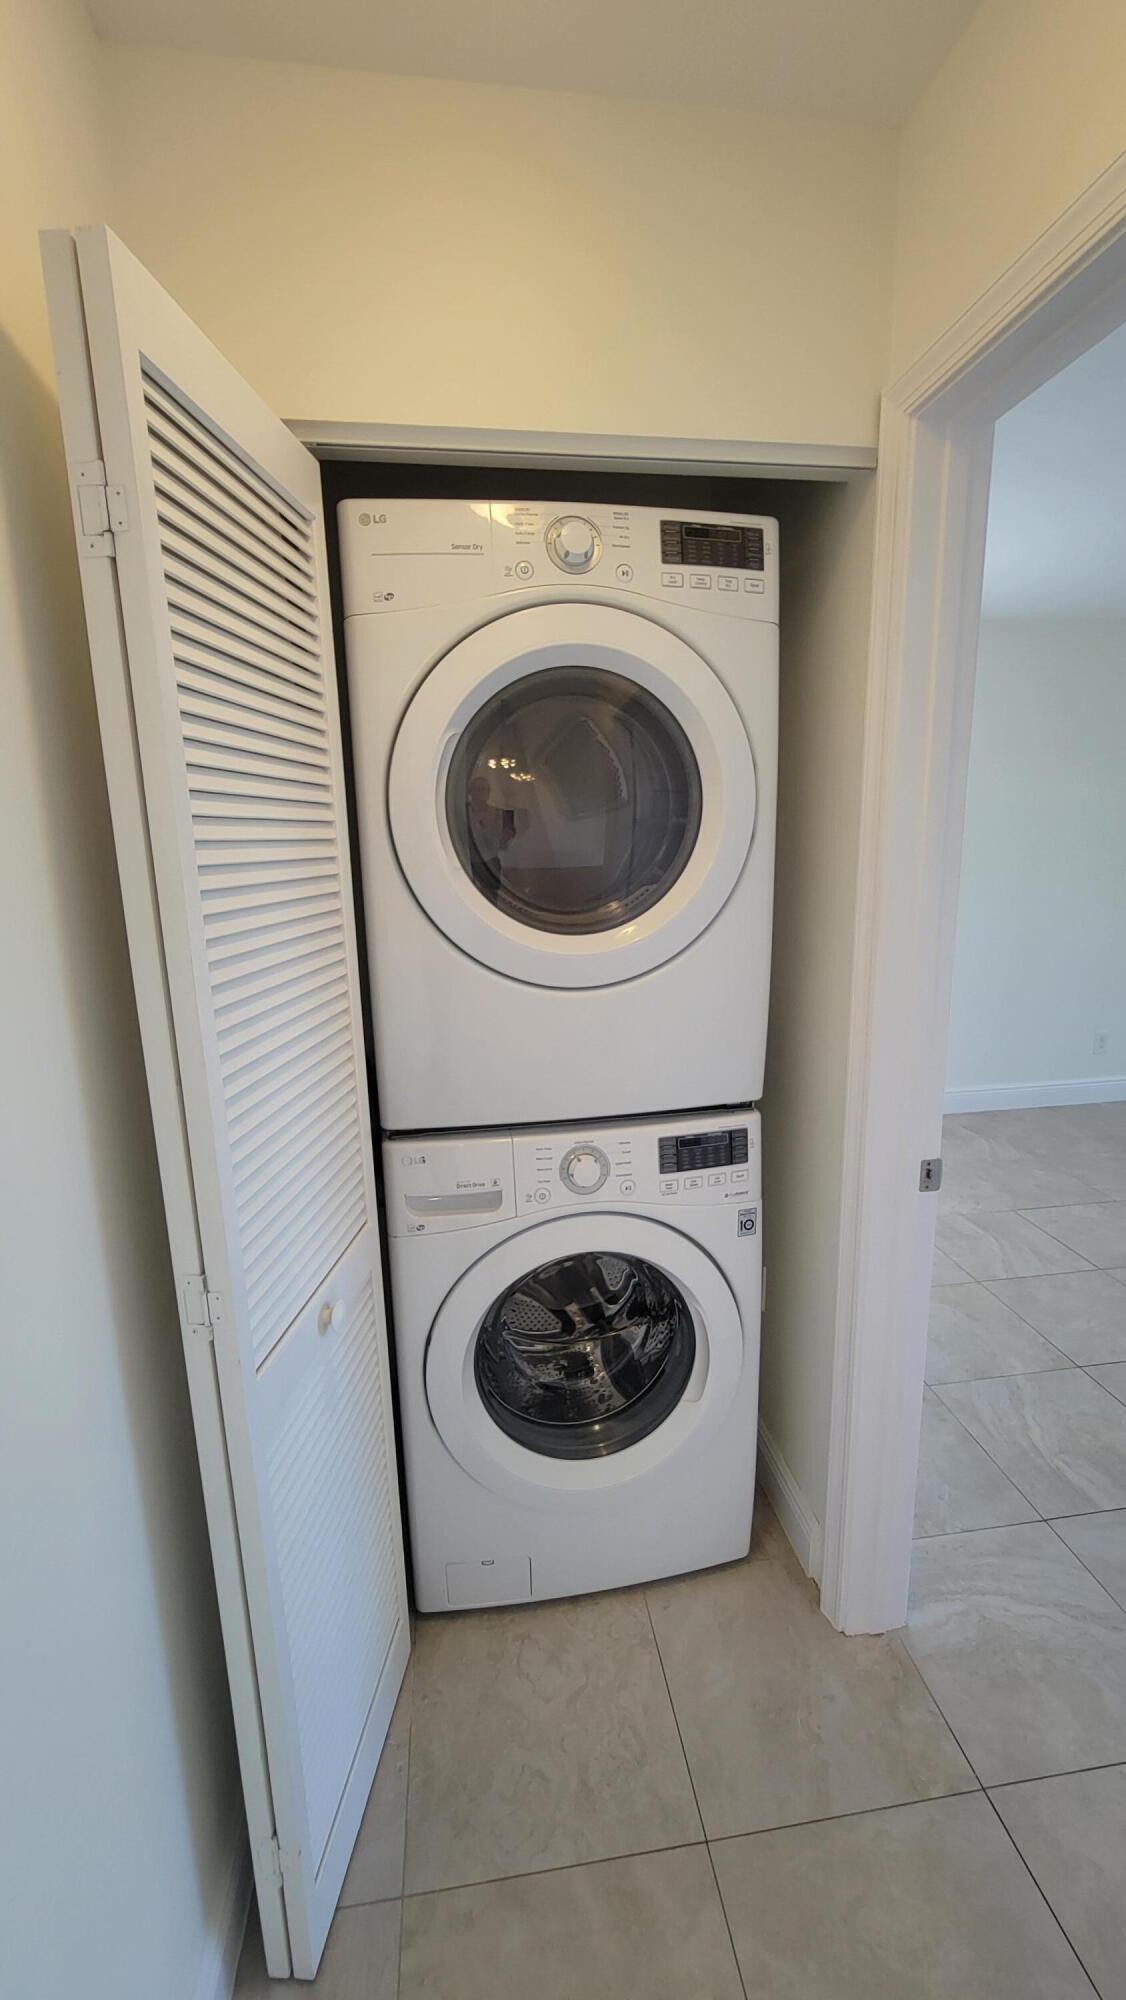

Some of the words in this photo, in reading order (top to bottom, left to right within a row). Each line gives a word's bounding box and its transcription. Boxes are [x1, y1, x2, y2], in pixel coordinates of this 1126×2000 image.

[373, 514, 387, 524] LG
[451, 543, 471, 551] Sensor
[472, 543, 483, 551] Dry
